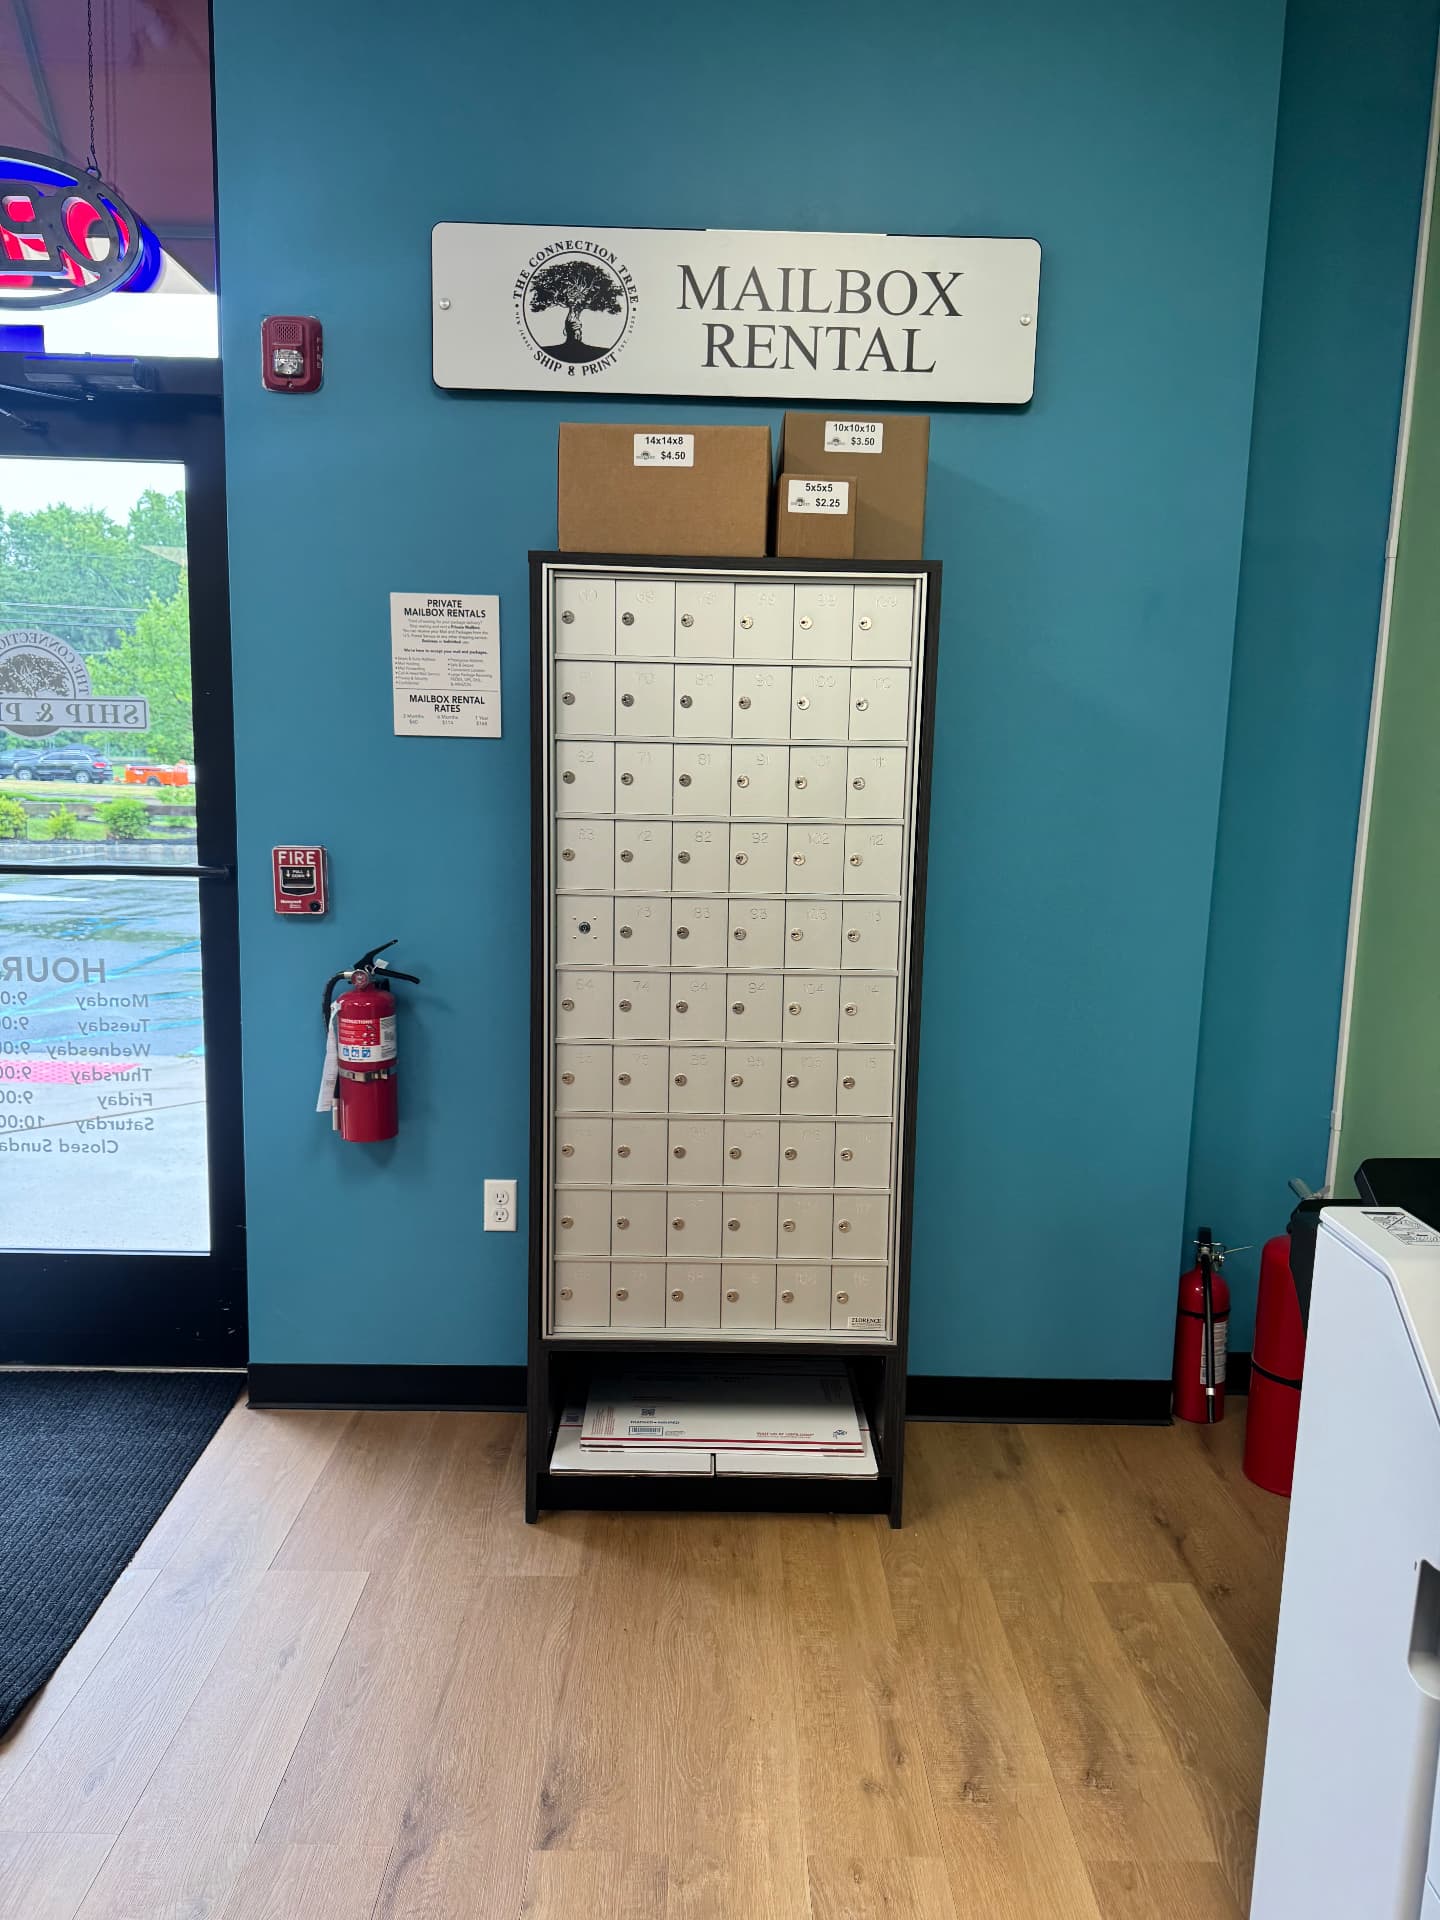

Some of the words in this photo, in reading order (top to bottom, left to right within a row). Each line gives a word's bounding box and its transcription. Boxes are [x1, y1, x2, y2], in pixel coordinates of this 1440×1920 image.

[512, 269, 530, 300] THE
[528, 240, 618, 267] CONNECTION
[617, 264, 639, 304] TREE
[676, 264, 964, 317] MAILBOX
[701, 323, 936, 374] RENTAL
[533, 350, 562, 372] SHIP
[567, 365, 576, 377] &
[581, 351, 619, 376] PRINT
[833, 423, 876, 433] 10x10x10
[645, 436, 684, 445] 14x14x8
[850, 436, 875, 446] $3.50
[660, 450, 686, 460] $4.50
[805, 483, 833, 493] 5x5x5
[815, 498, 841, 508] $2.25
[427, 599, 462, 608] PRIVATE
[404, 608, 444, 617] MAILBOX
[447, 609, 486, 618] RENTALS
[409, 695, 449, 704] MAILBOX
[451, 696, 485, 705] RENTAL
[434, 704, 461, 713] RATES
[278, 851, 316, 864] FIRE
